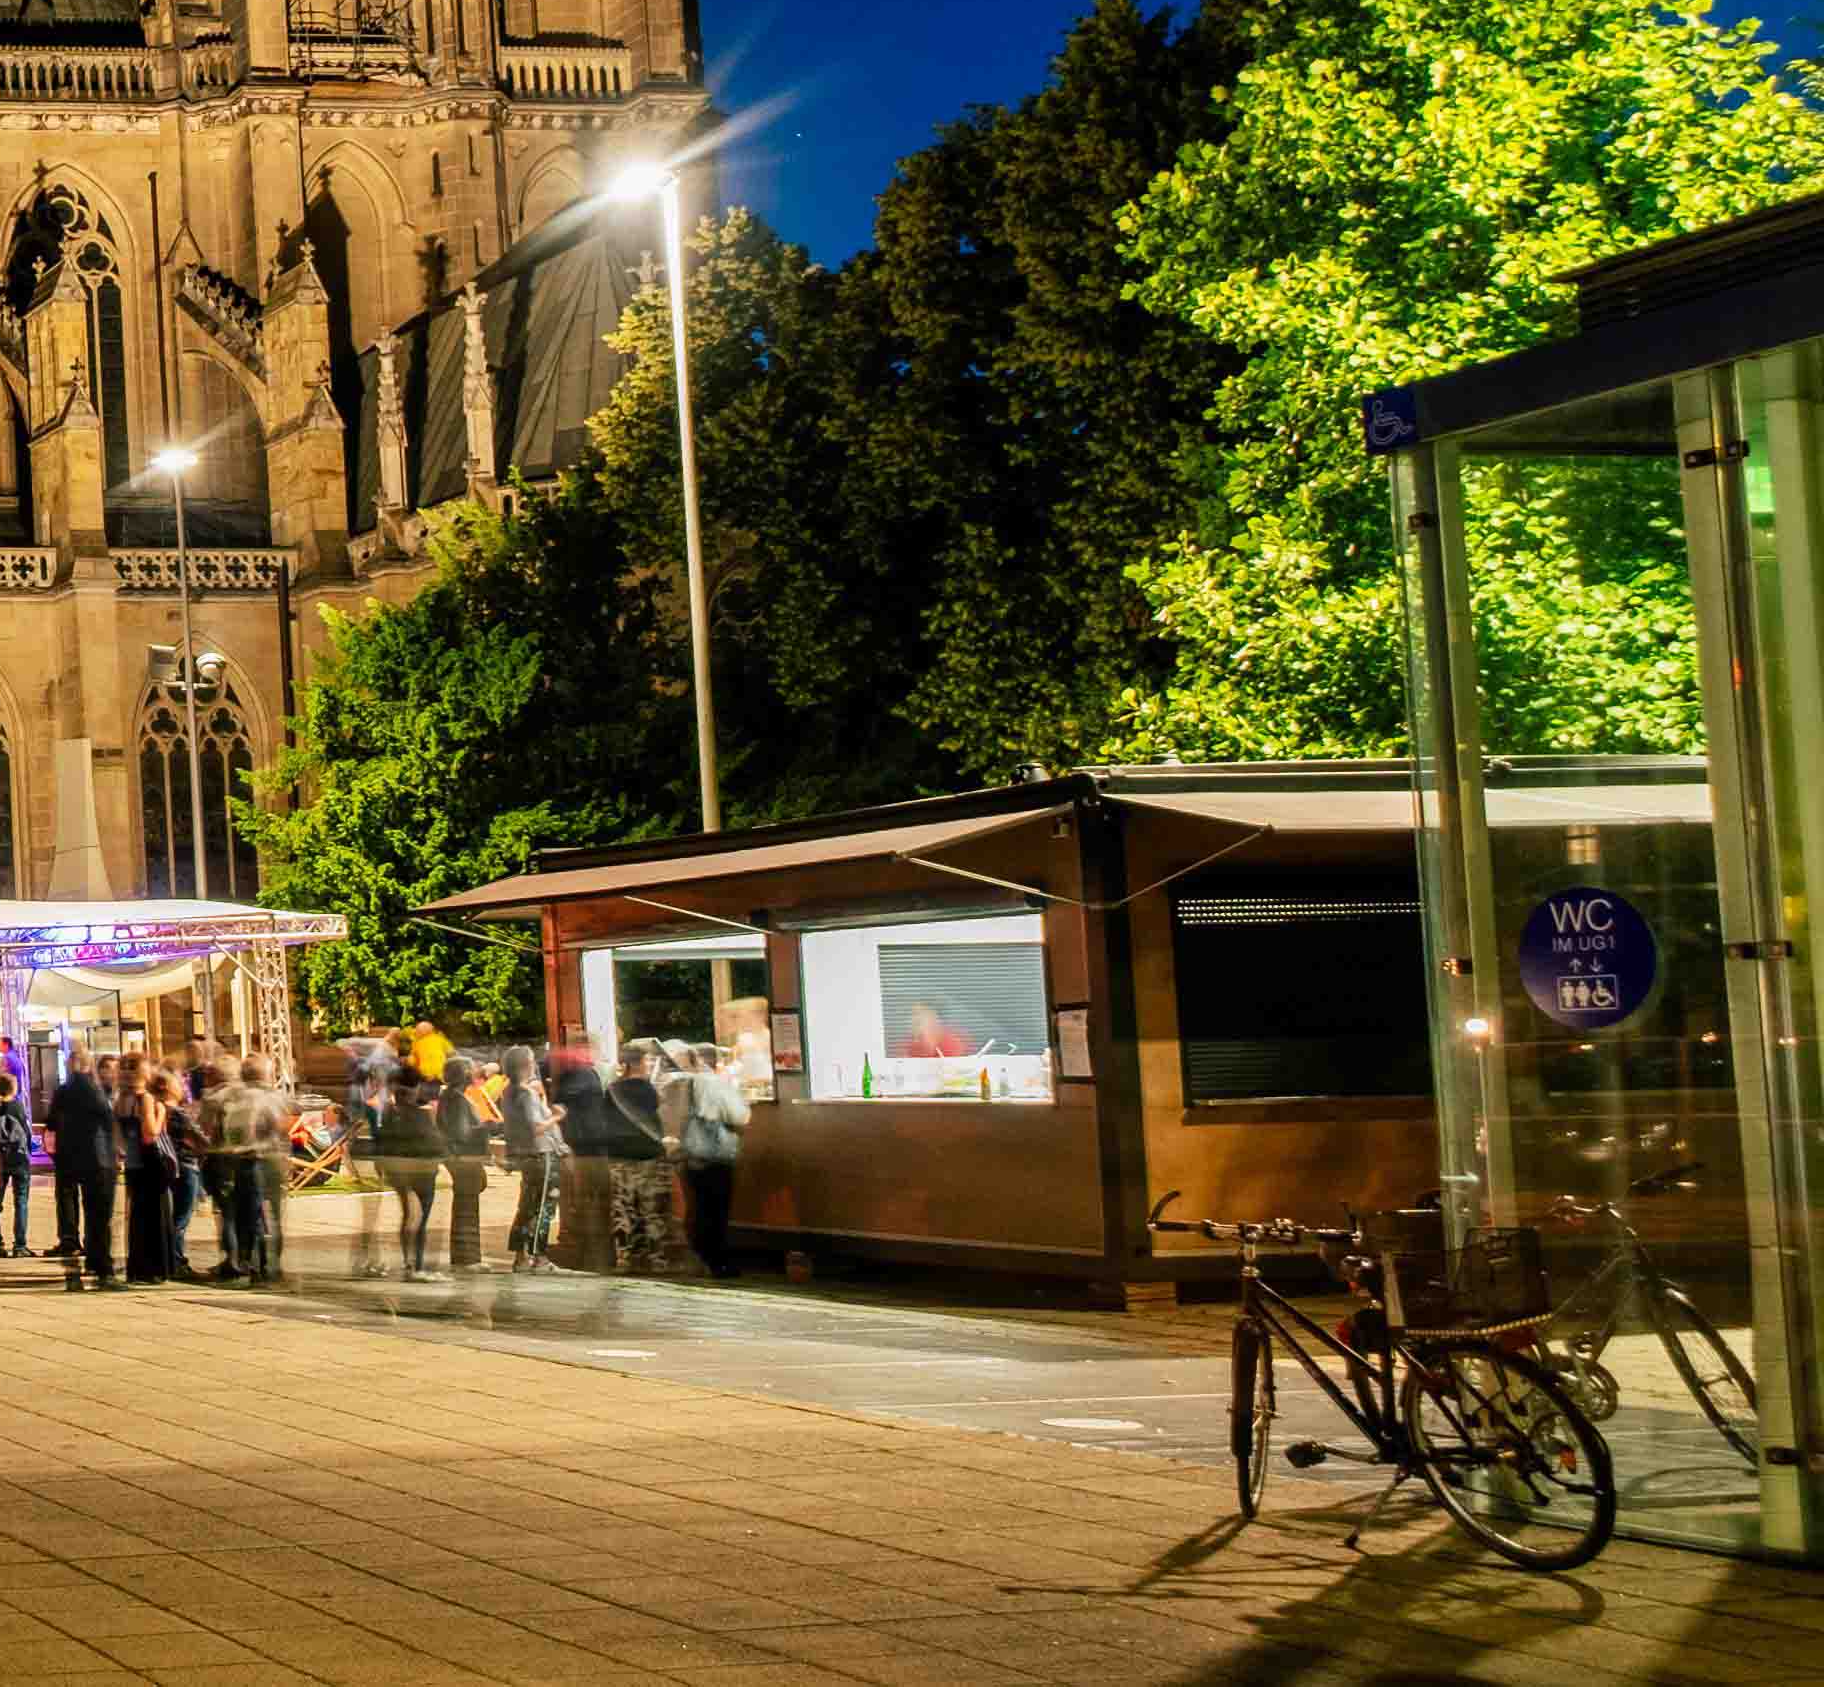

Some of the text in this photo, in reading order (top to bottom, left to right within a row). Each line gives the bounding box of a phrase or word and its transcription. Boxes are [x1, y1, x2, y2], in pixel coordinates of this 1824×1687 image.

[1549, 898, 1613, 933] WC
[1552, 935, 1615, 952] IM UG1
